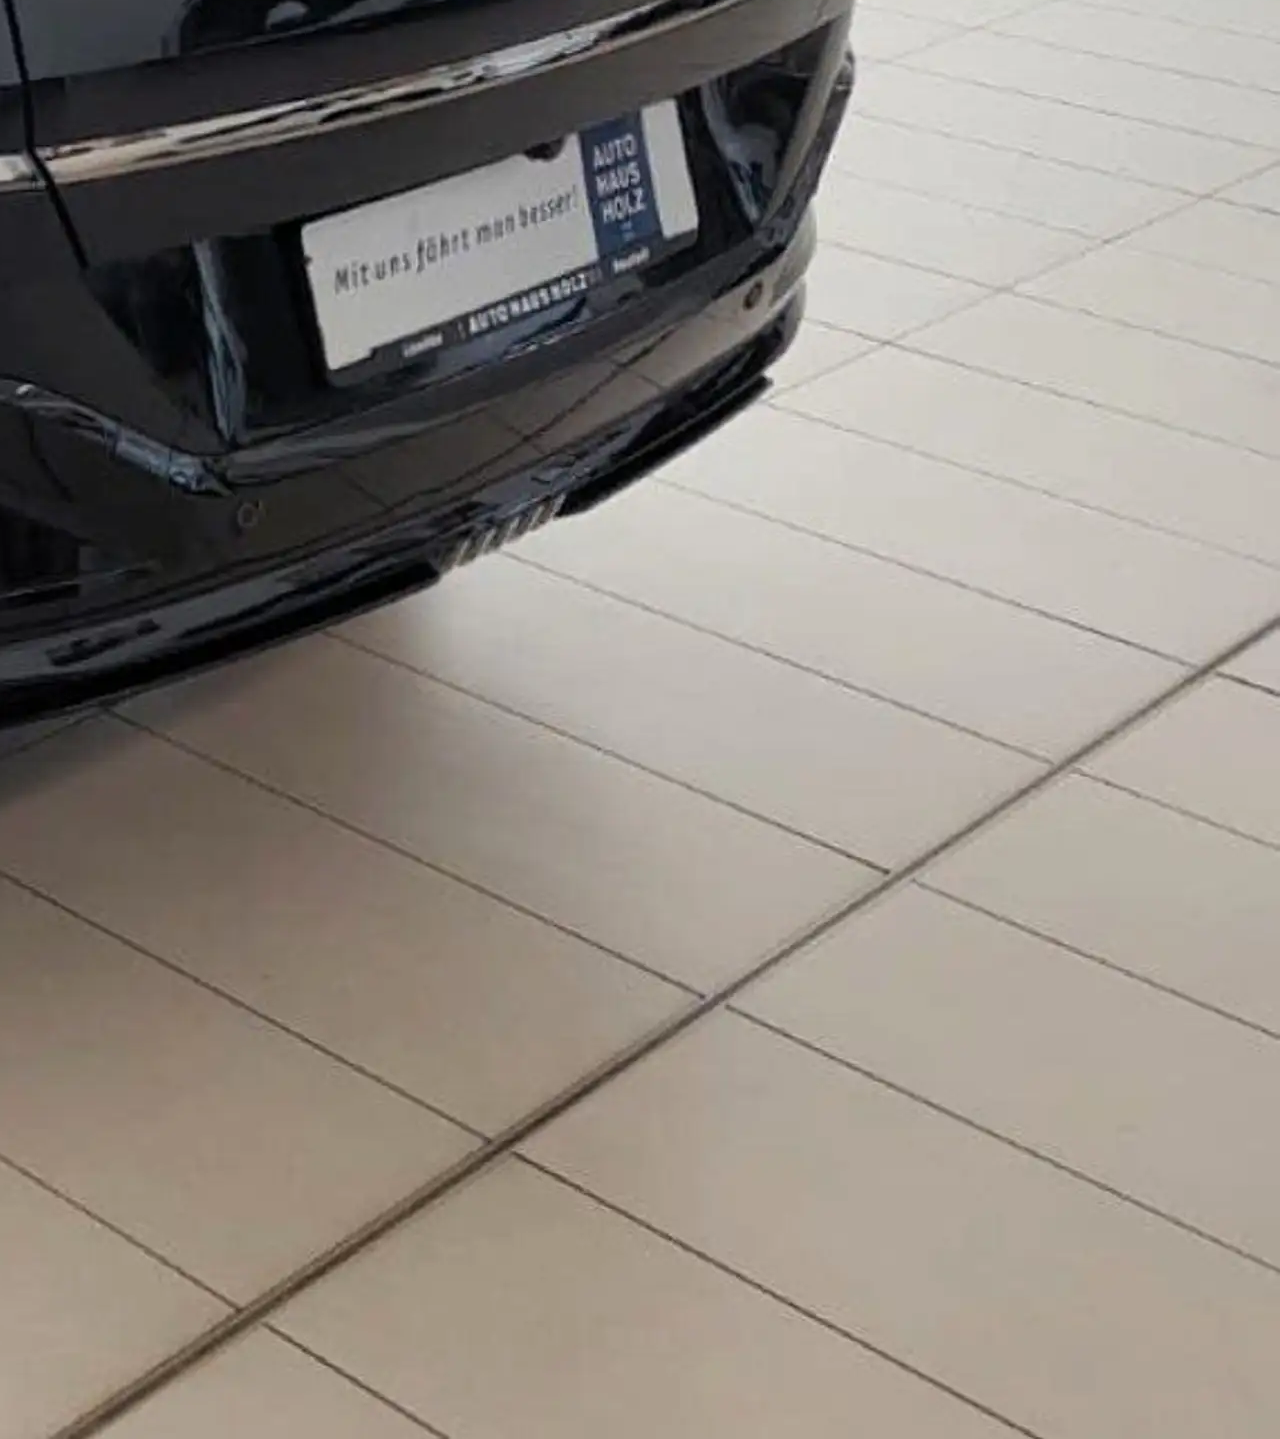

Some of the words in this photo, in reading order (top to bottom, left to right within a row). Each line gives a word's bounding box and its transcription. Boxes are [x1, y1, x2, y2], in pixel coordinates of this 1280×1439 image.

[593, 133, 638, 169] AUTO
[595, 162, 641, 198] HAUS
[603, 187, 647, 224] HOLZ
[334, 263, 370, 295] Mit
[374, 251, 412, 281] uns
[475, 213, 515, 246] man
